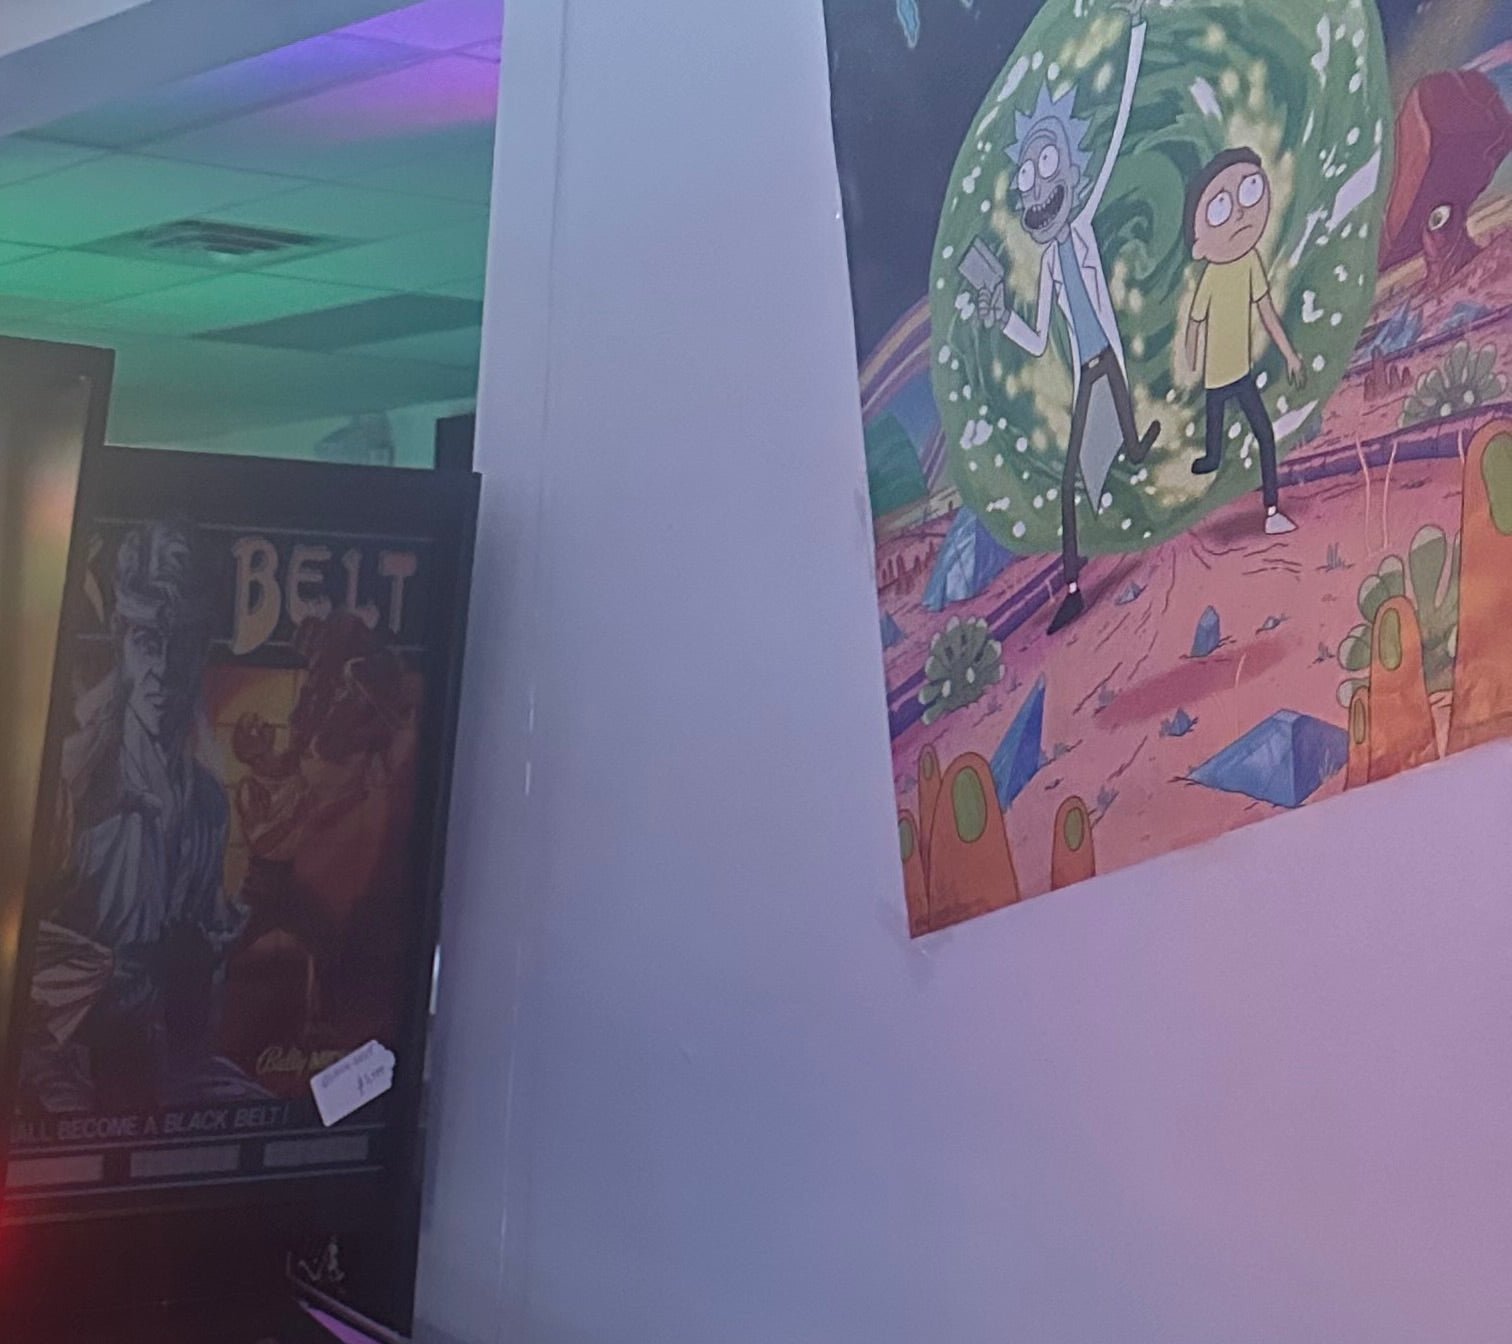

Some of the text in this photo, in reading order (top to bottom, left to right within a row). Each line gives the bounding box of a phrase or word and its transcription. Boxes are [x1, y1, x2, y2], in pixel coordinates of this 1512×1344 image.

[230, 535, 418, 656] BELT
[57, 1115, 139, 1141] BECOME
[143, 1115, 160, 1136] A
[163, 1108, 229, 1134] BLACK
